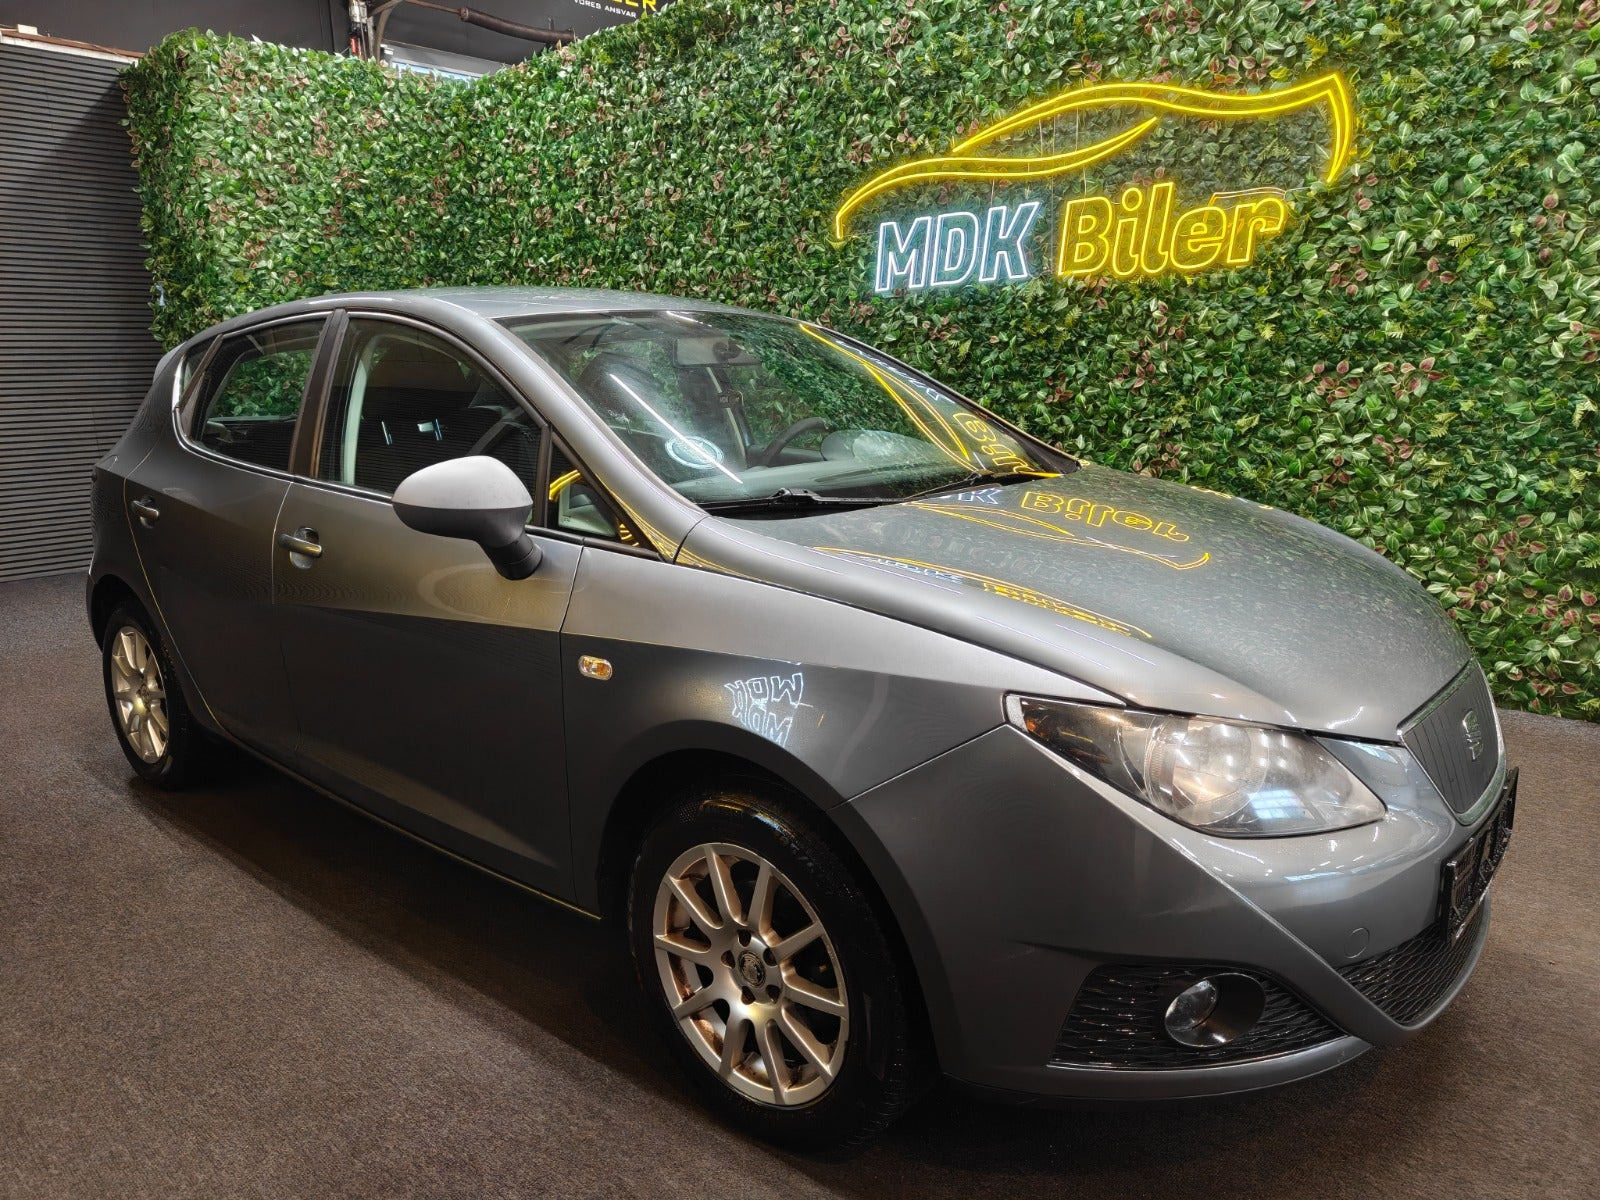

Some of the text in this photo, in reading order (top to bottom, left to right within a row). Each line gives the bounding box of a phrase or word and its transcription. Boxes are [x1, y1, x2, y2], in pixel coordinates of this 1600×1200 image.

[604, 5, 636, 18] ANSVAR
[875, 181, 1286, 292] MDK Biler
